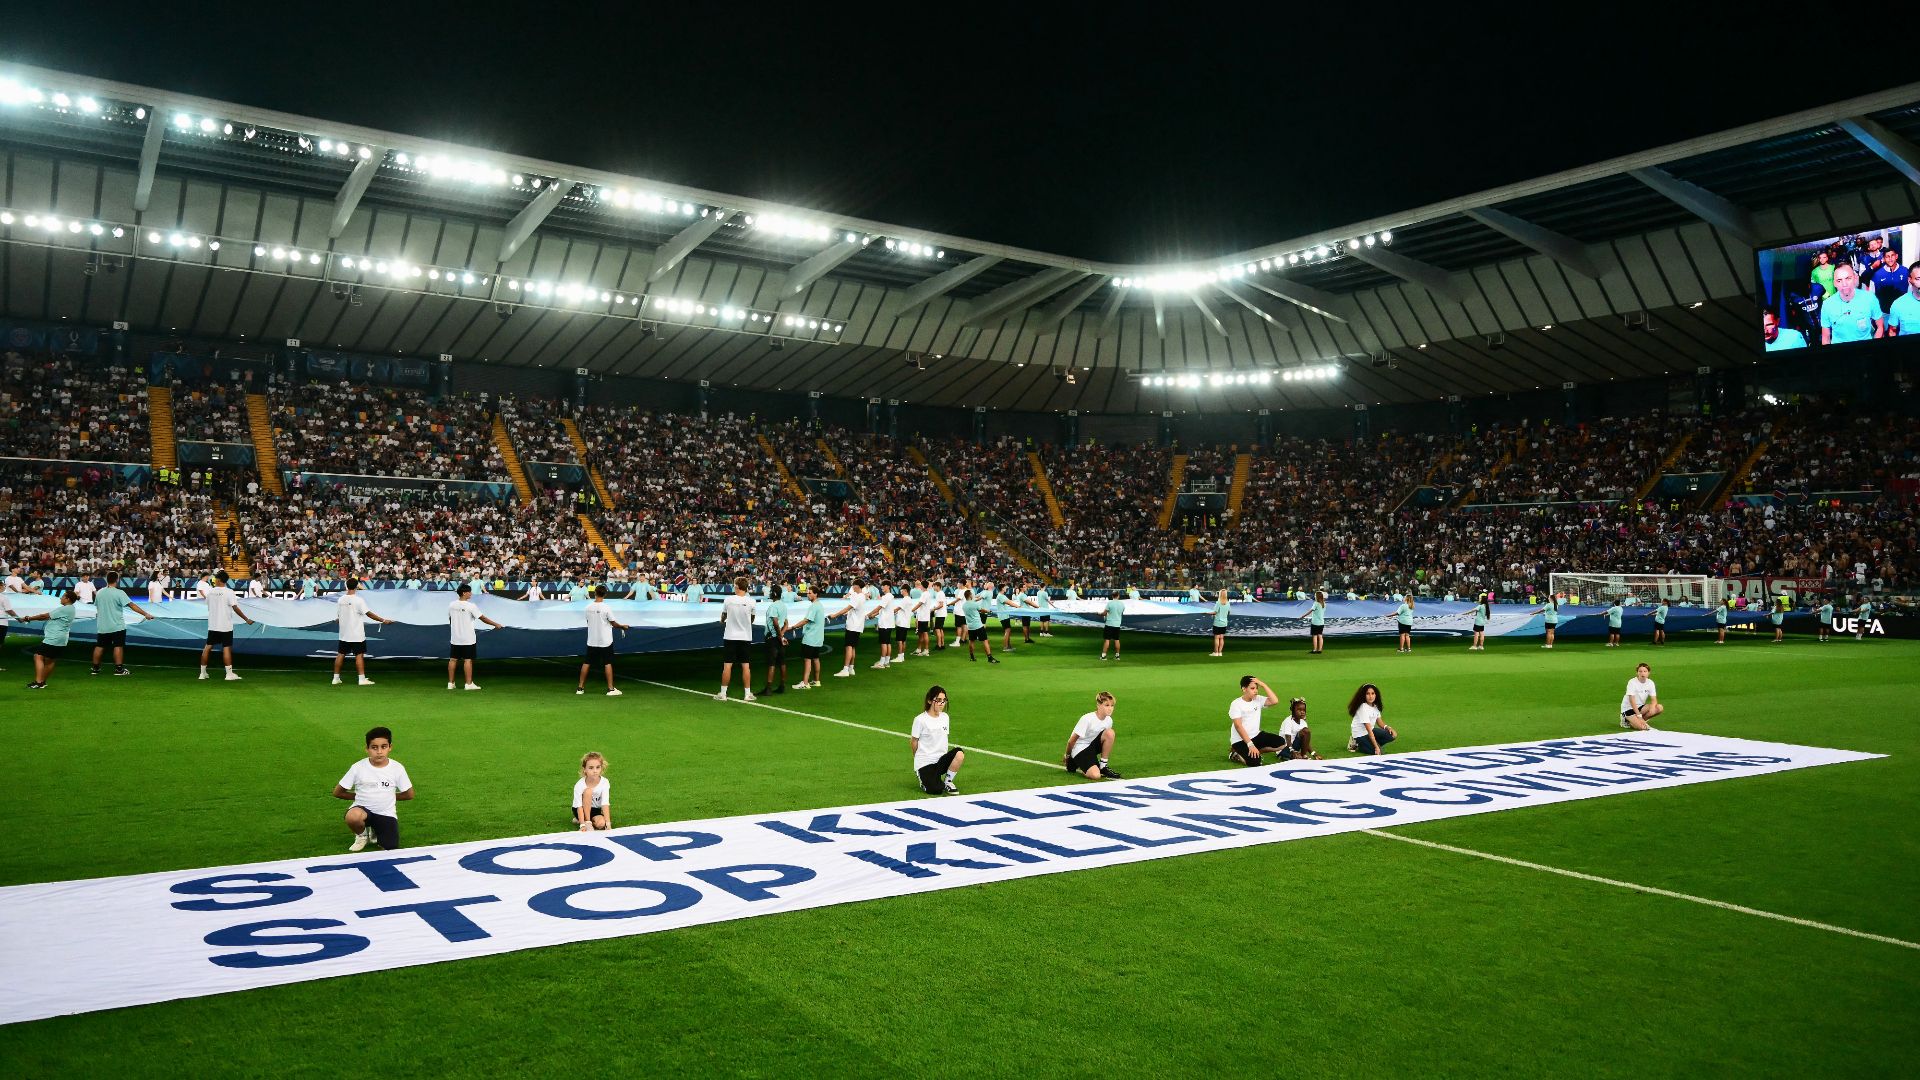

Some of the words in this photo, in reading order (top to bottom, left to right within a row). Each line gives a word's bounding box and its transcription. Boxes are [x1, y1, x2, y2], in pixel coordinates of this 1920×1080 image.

[1832, 617, 1885, 634] UEFA
[169, 830, 724, 912] STOP
[755, 777, 1277, 844] KILLING
[1269, 737, 1683, 785] CHILDREN
[204, 862, 817, 969] STOP
[844, 798, 1398, 879] KILLING
[1379, 751, 1792, 805] CIVILIANS
